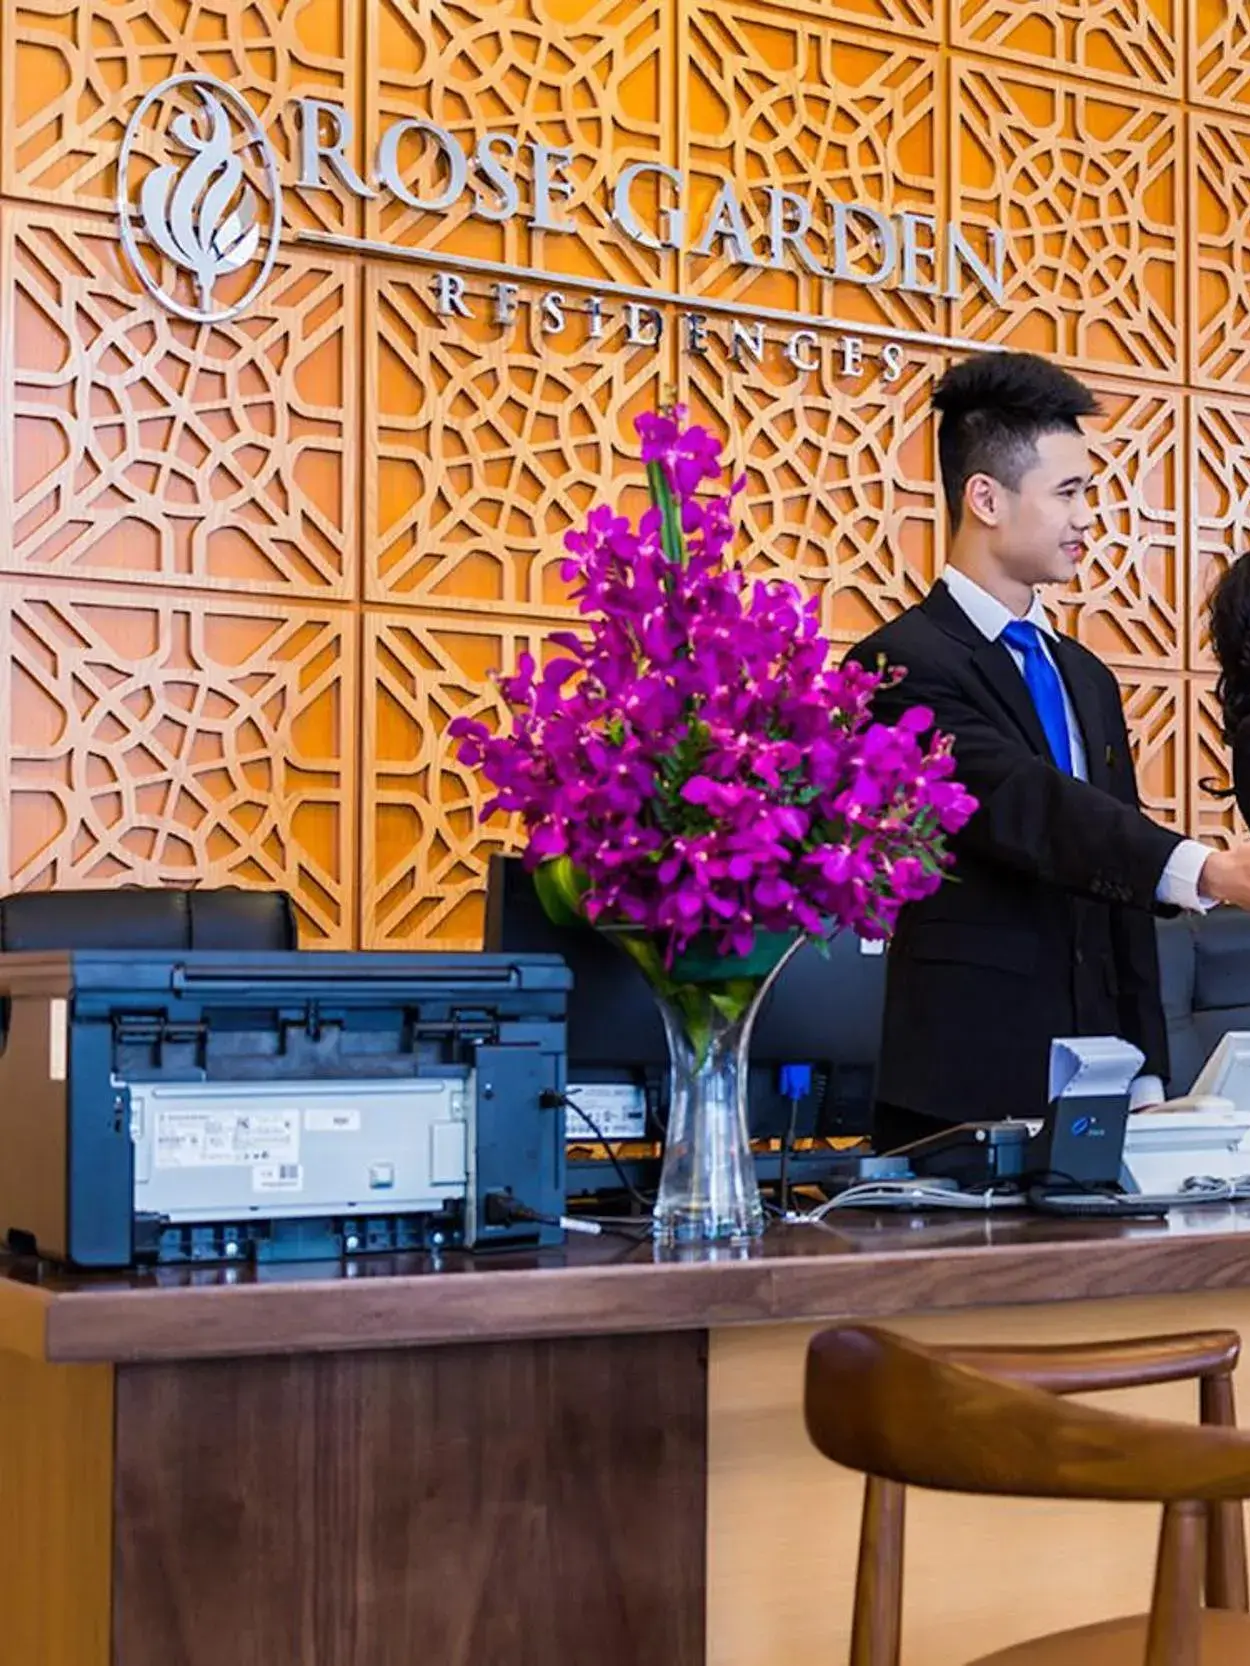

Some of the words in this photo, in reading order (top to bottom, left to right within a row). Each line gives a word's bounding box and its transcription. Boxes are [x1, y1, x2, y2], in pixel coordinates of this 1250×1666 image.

[290, 97, 577, 235] ROSE
[611, 162, 1004, 306] GARDEN
[433, 271, 904, 383] RESIDENCES
